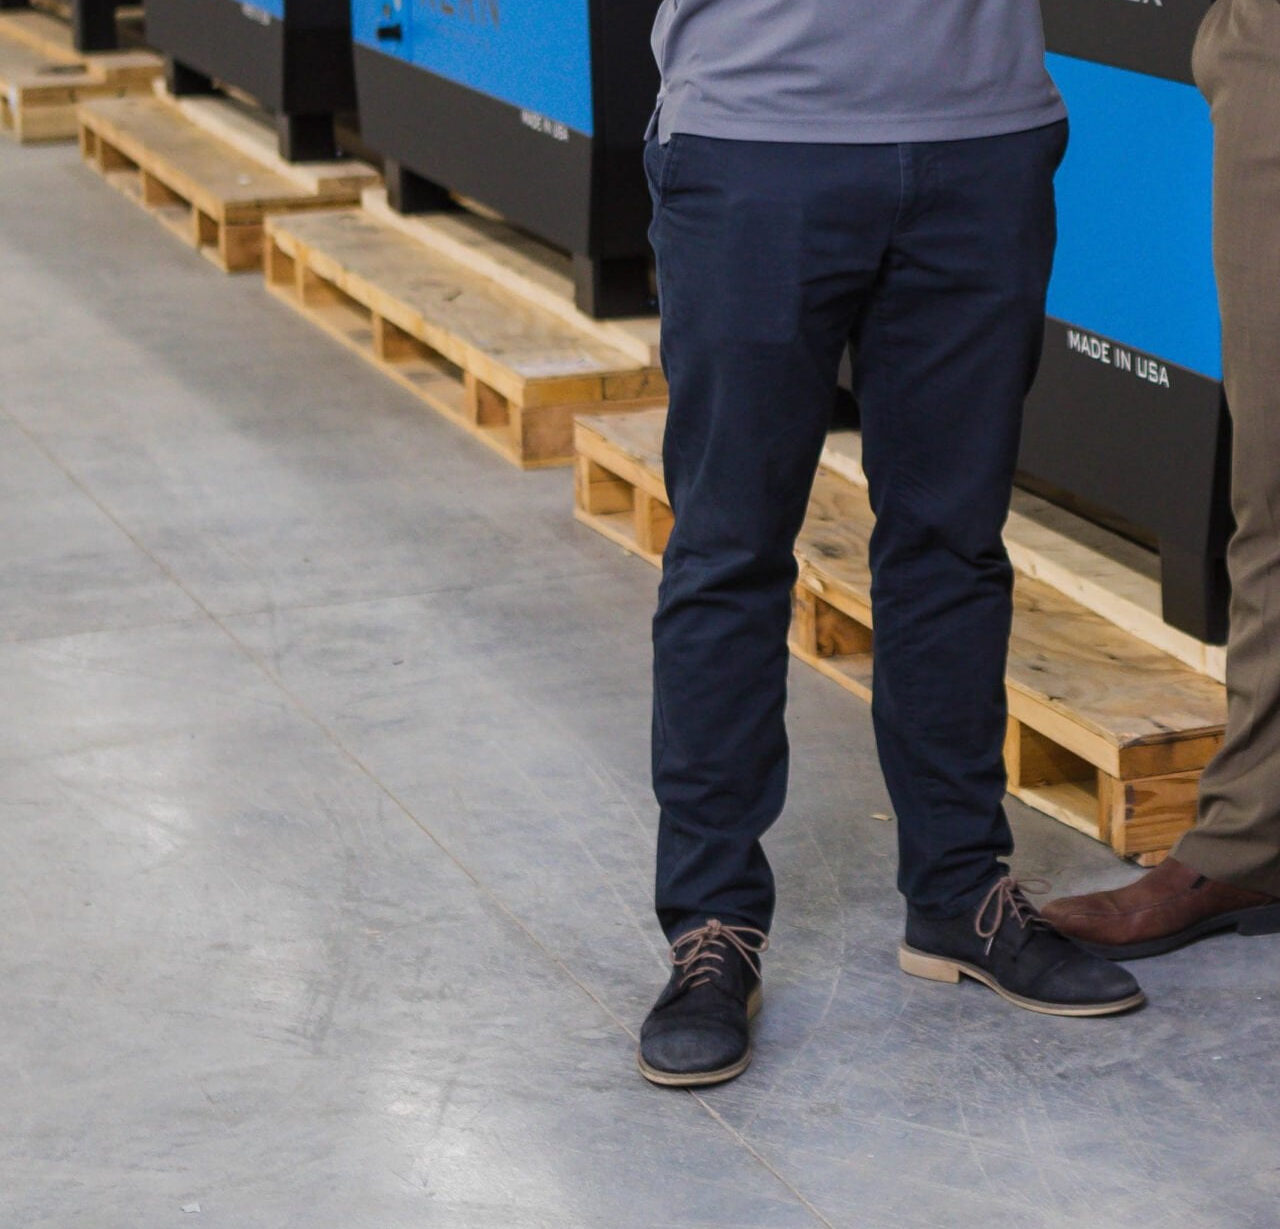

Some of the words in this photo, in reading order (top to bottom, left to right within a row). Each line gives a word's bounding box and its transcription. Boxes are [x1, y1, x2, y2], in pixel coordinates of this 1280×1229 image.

[1067, 329, 1110, 364] MADE
[1113, 346, 1131, 372] IN
[1135, 355, 1169, 389] USA
